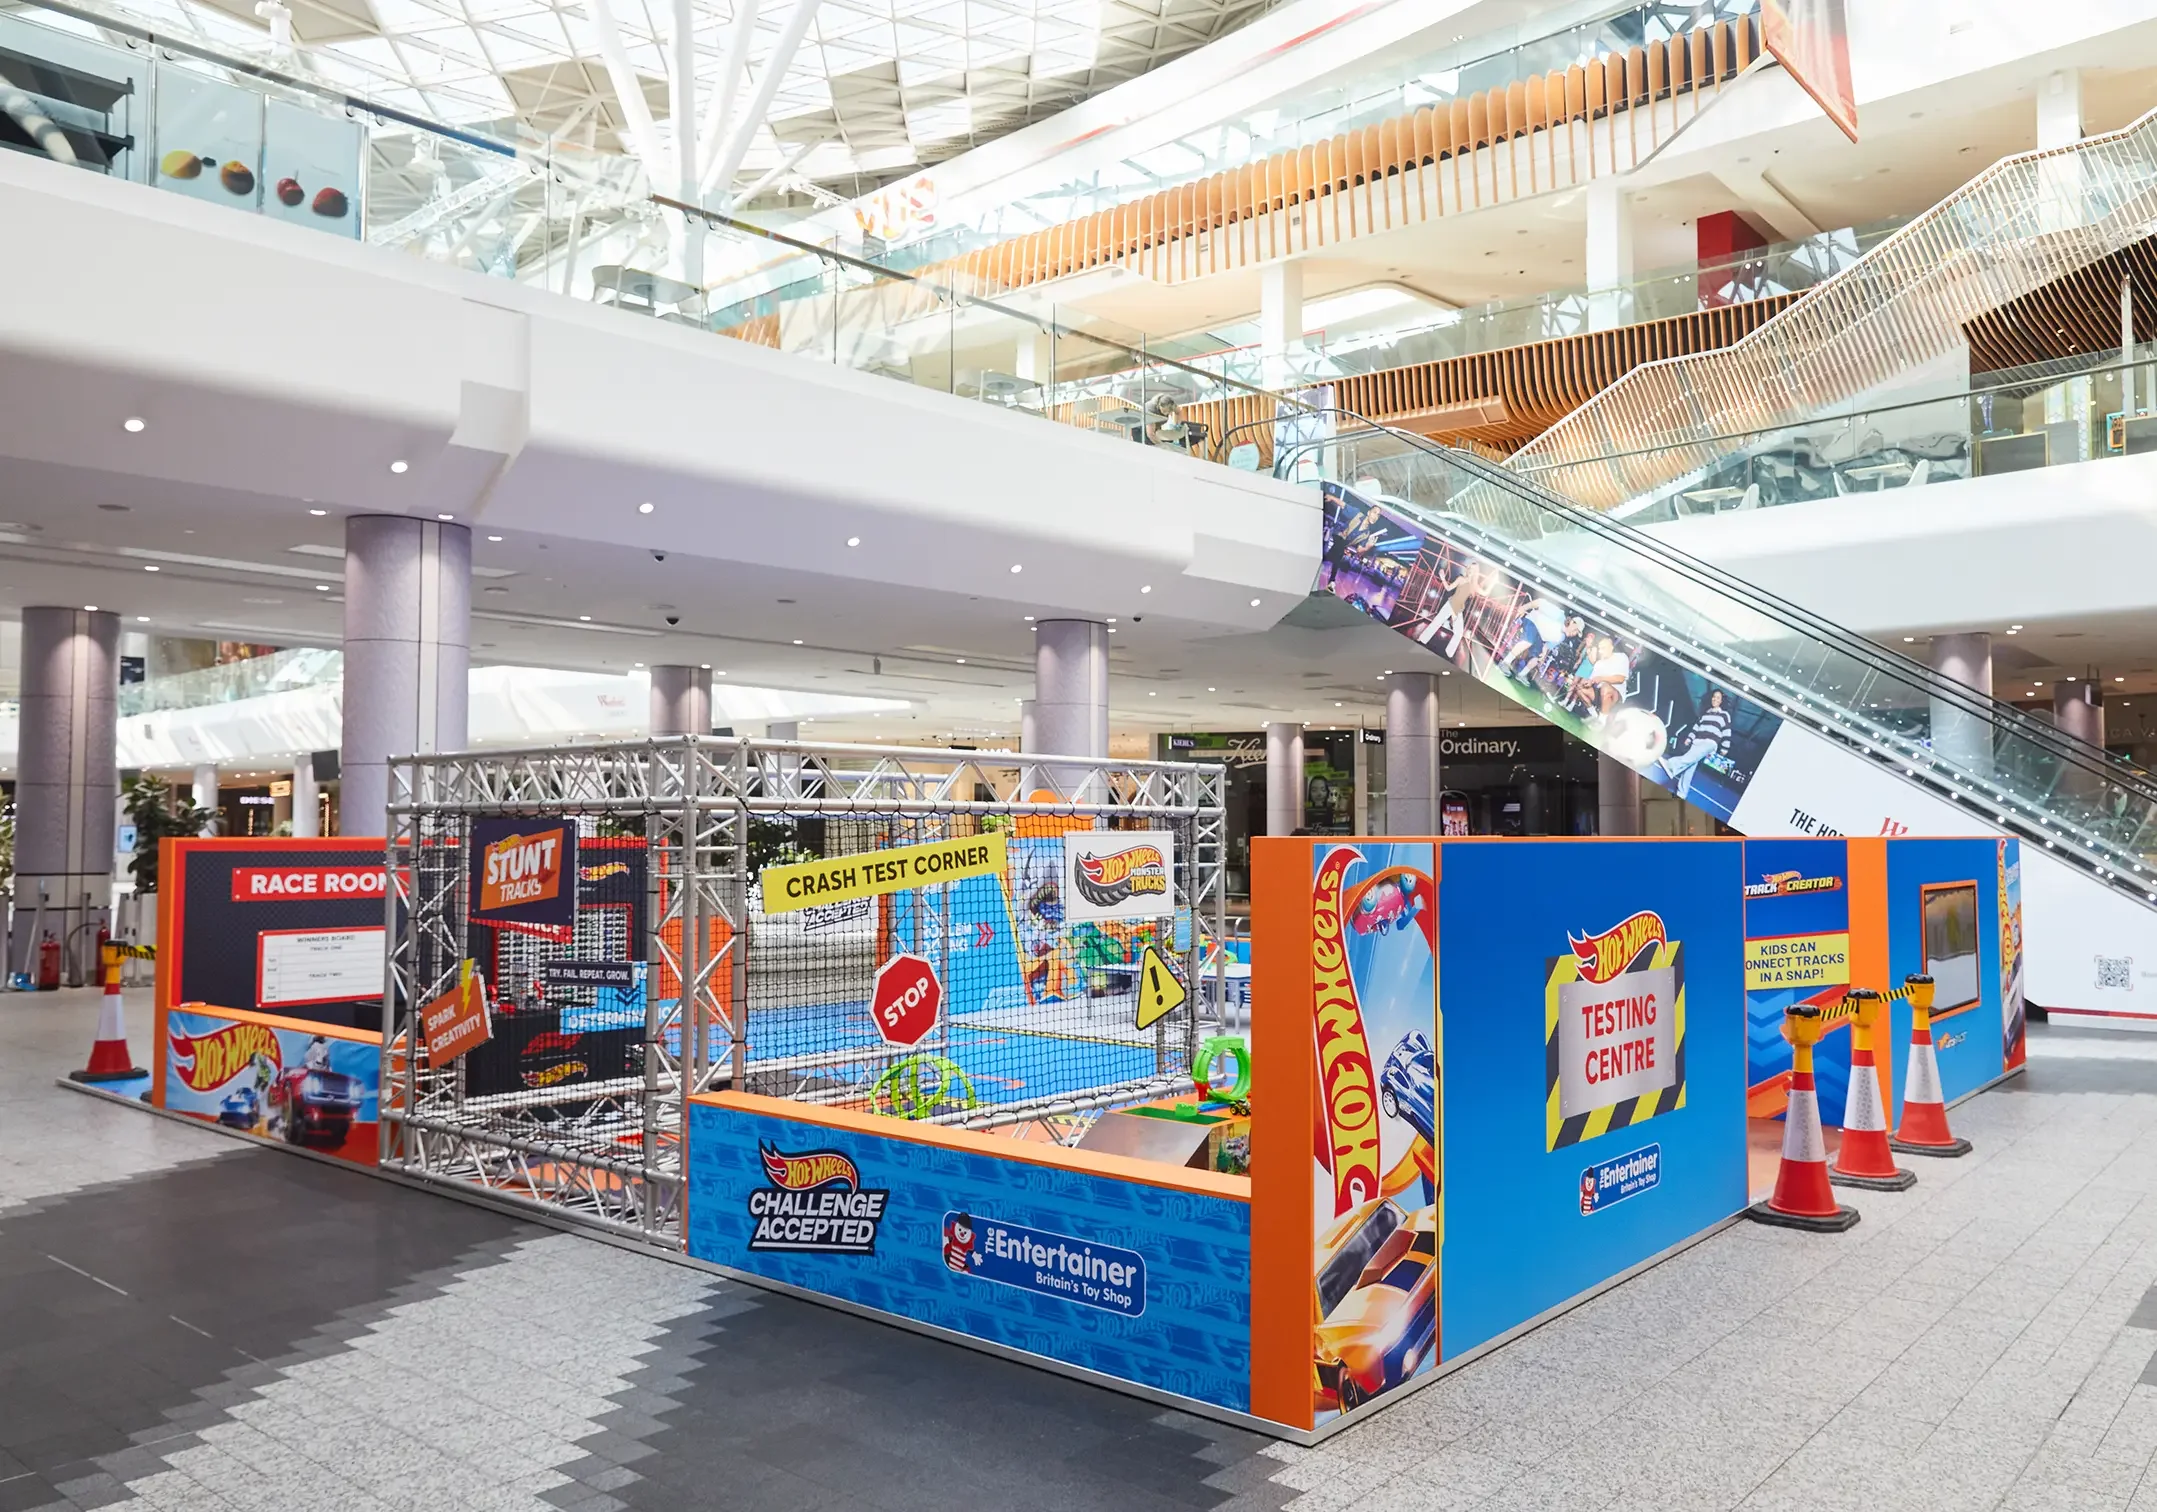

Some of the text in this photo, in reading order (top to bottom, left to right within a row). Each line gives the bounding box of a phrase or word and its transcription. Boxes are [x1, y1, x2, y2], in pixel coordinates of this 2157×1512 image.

[1440, 738, 1521, 758] Ordinary.
[1788, 808, 1817, 834] THE
[487, 838, 556, 885] STUNT
[786, 845, 989, 898] CRASH TEST CORNER
[1130, 867, 1164, 876] MONSTER
[251, 873, 318, 894] RACE
[500, 878, 542, 902] TRACKS
[1130, 875, 1166, 893] TRUCKS
[1745, 882, 1778, 896] TRACK
[1786, 876, 1834, 891] CREATOR
[1745, 953, 1845, 970] ONNECT TRACKS
[1760, 941, 1817, 956] KIDS CAN
[549, 968, 562, 978] TRY.
[563, 969, 578, 979] FAIL.
[579, 969, 604, 980] REPEAT.
[606, 970, 630, 981] GROW.
[1760, 968, 1825, 983] IN A SNAP!
[884, 977, 929, 1027] STOP
[427, 1004, 457, 1032] SPARK
[1582, 993, 1657, 1040] TESTING
[431, 1012, 481, 1053] CREATIVITY
[1585, 1036, 1655, 1085] CENTRE
[1603, 1152, 1658, 1188] Entertainer
[750, 1192, 884, 1218] CHALLENGE
[755, 1217, 875, 1244] ACCEPTED
[984, 1227, 995, 1254] The
[995, 1229, 1137, 1288] Entertainer
[1036, 1271, 1079, 1294] Britain's
[1081, 1282, 1101, 1301] Toy
[1103, 1288, 1132, 1309] Shop
